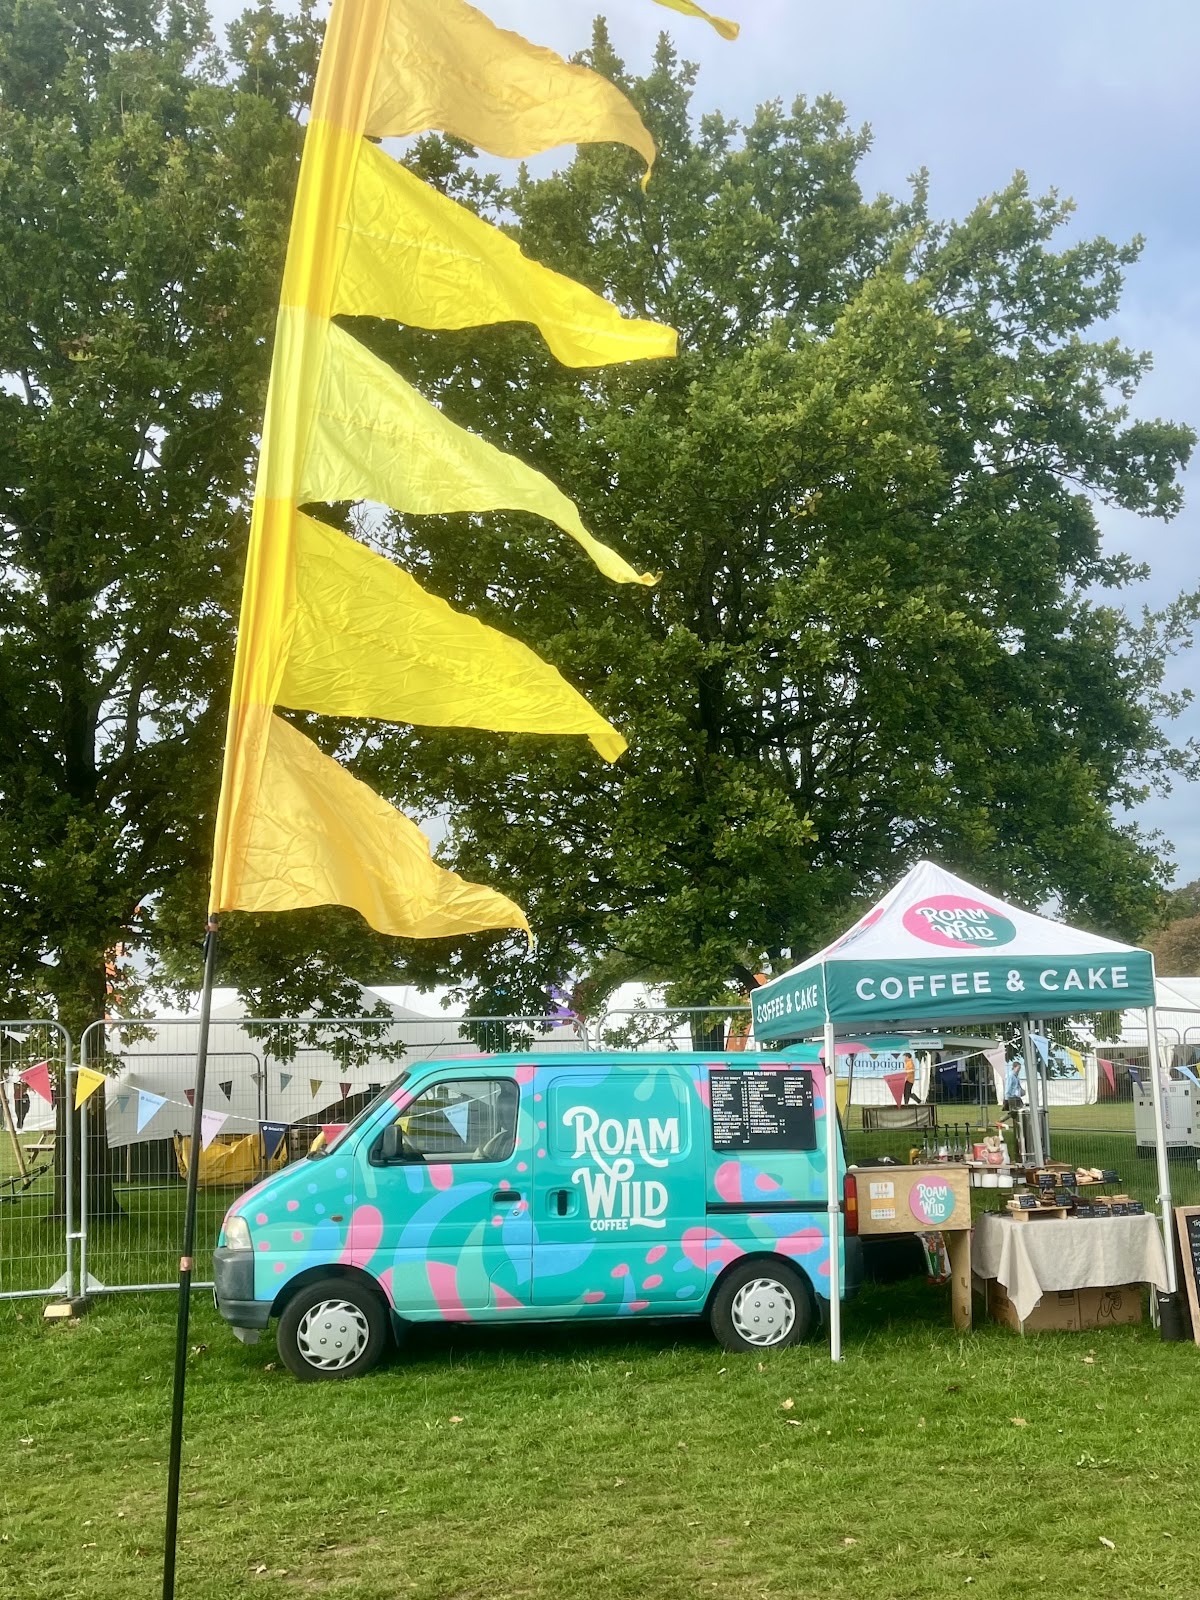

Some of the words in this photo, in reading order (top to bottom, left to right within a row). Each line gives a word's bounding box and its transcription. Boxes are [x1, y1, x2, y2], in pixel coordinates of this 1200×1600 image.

[915, 907, 990, 925] ROAM
[931, 920, 997, 940] WILD
[856, 972, 991, 1000] COFFEE
[1006, 970, 1026, 992] &
[1039, 966, 1128, 991] CAKE
[757, 995, 784, 1023] COFFEE
[786, 993, 792, 1013] &
[794, 984, 818, 1012] CAKE
[846, 1057, 904, 1070] Campaign
[563, 1106, 680, 1172] ROAM
[572, 1158, 668, 1228] WILD
[916, 1184, 947, 1200] ROAM
[920, 1198, 945, 1216] WILD
[590, 1219, 628, 1231] COFFEE
